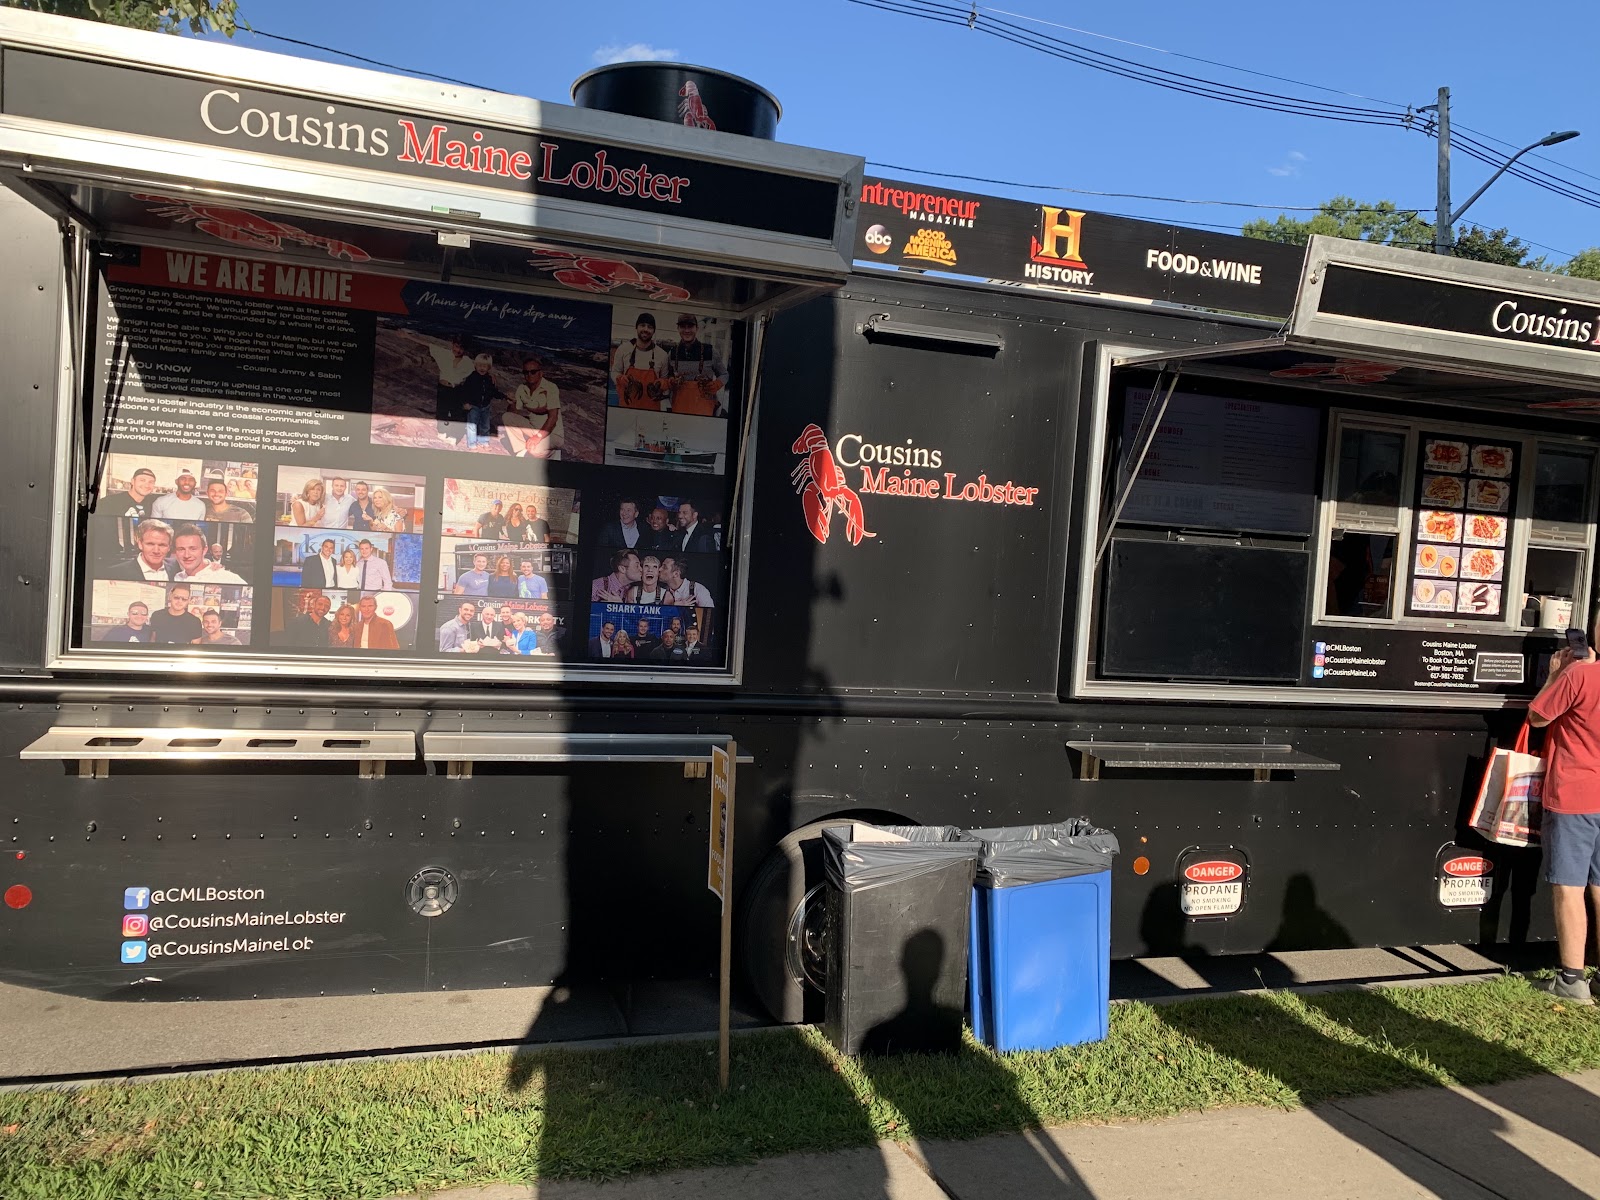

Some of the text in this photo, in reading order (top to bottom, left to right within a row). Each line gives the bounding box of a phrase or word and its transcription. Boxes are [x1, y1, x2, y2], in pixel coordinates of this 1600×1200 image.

[200, 88, 690, 204] Cousins Maine Lobster
[860, 182, 980, 219] ntrepreneur
[909, 211, 974, 228] MAGAZINE
[865, 231, 892, 246] abc
[917, 229, 945, 240] GOOD
[1039, 206, 1087, 262] H
[910, 236, 952, 249] MORNING
[903, 243, 957, 260] AMERICA
[166, 252, 353, 302] WE ARE MAINE
[1024, 263, 1094, 286] HISTORY
[417, 291, 458, 306] Maine
[464, 299, 492, 318] just
[500, 302, 522, 319] few
[523, 305, 545, 323] steps
[548, 313, 576, 328] away
[1493, 301, 1592, 342] Cousins
[105, 358, 191, 373] DID YOU KNOW
[279, 368, 307, 377] Jimmy
[159, 375, 189, 383] lobster
[191, 378, 219, 387] fishery
[231, 382, 260, 390] upheld
[190, 386, 223, 394] capture
[157, 398, 187, 406] lobster
[189, 401, 224, 410] industry
[252, 407, 293, 416] economic
[314, 412, 344, 420] cultural
[179, 408, 210, 416] islands
[160, 437, 202, 445] members
[235, 434, 260, 442] proud
[273, 438, 305, 447] support
[265, 429, 309, 439] productive
[311, 433, 339, 441] bodies
[836, 434, 942, 469] Cousins
[859, 465, 1038, 506] Maine Lobster
[474, 486, 562, 506] Maine Lobster
[303, 533, 360, 555] ktie
[473, 543, 496, 551] Cousins
[525, 601, 548, 612] Lobster
[606, 603, 661, 615] SHARK TANK
[1326, 644, 1361, 652] @CMLBoston
[1434, 649, 1454, 657] Boston,
[1324, 668, 1377, 677] @CousinsMaineLob
[1193, 867, 1235, 877] DANGER
[1450, 862, 1487, 871] DANGER
[1185, 885, 1238, 895] PROPANE
[1444, 879, 1490, 888] PROPANE
[151, 886, 265, 905] @CMLBoston
[149, 909, 346, 931] @CousinsMaineLobster
